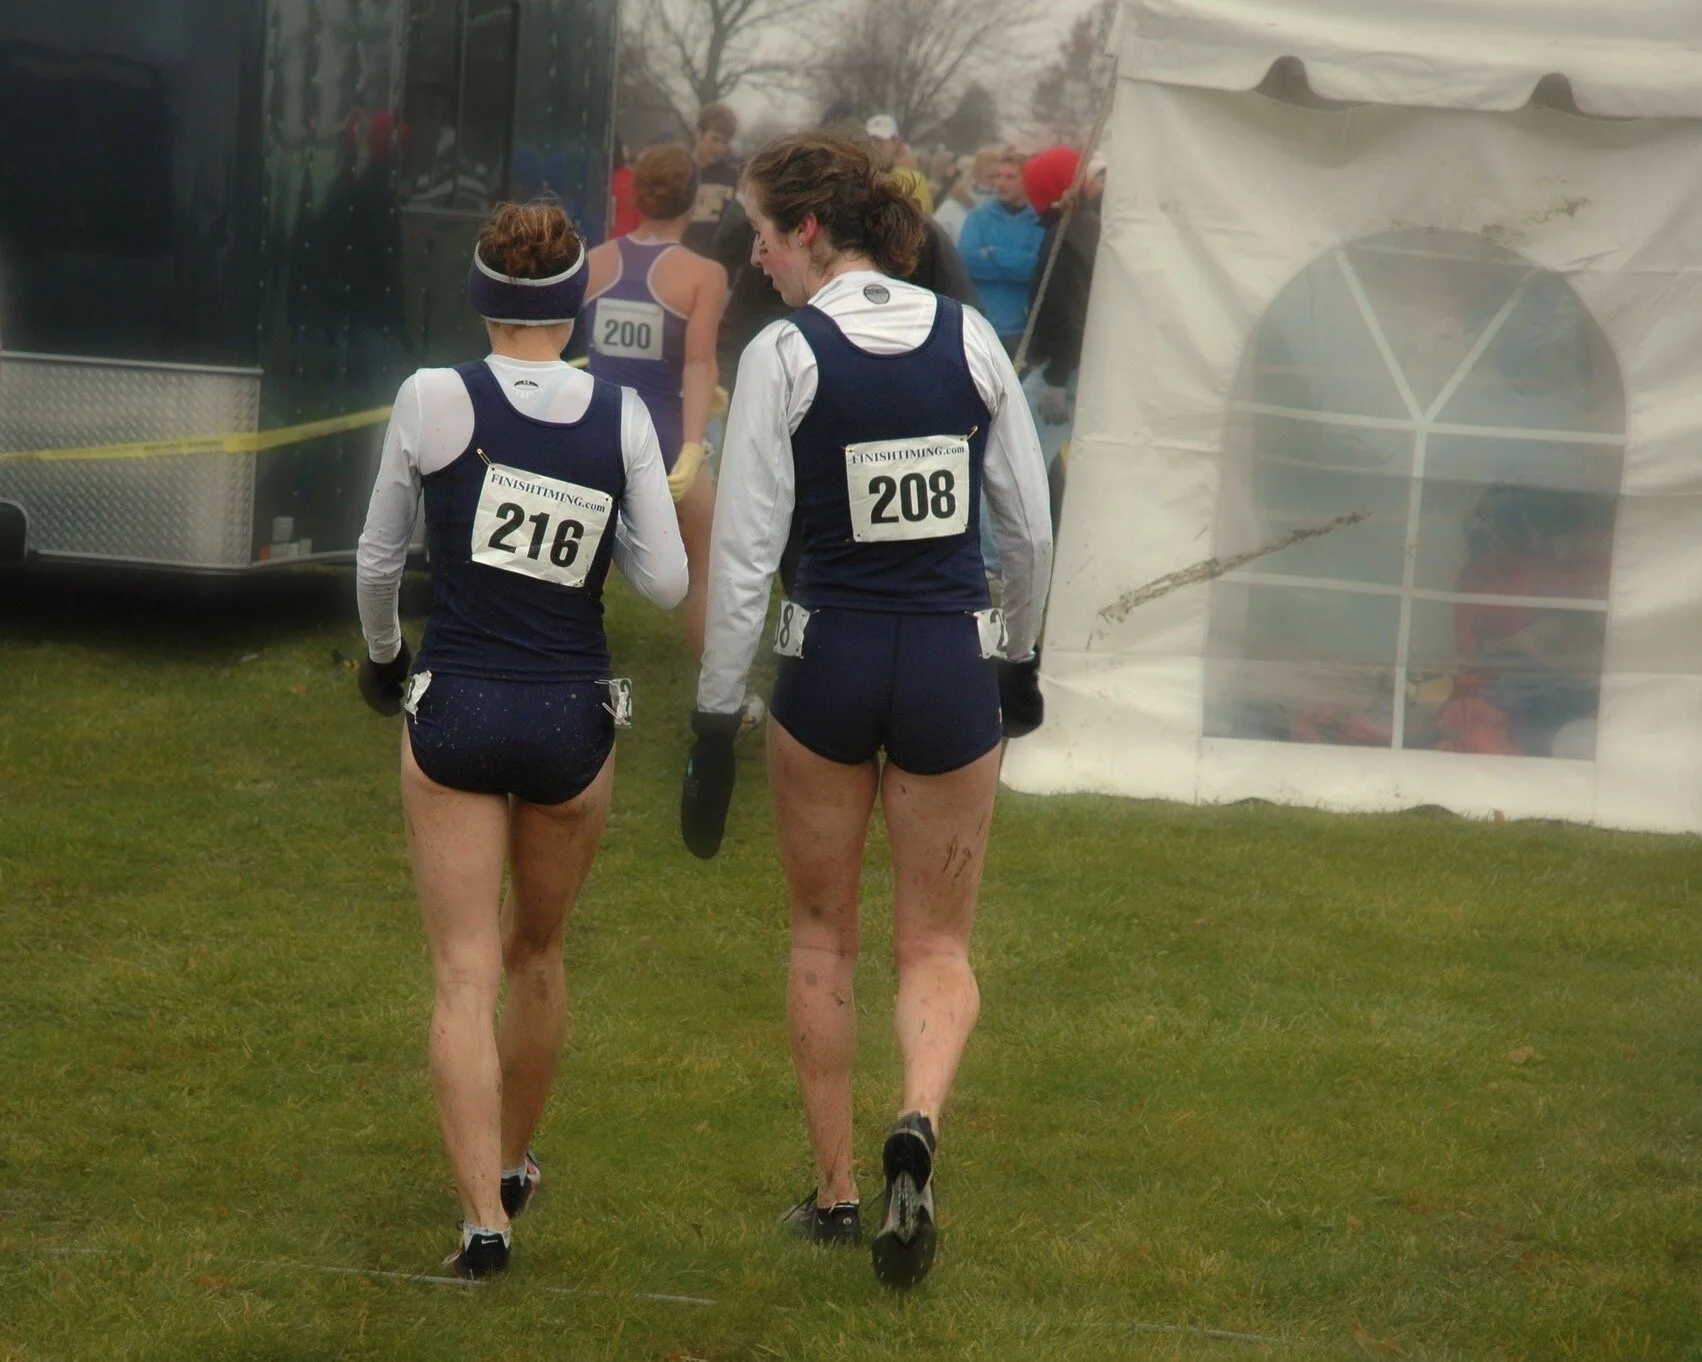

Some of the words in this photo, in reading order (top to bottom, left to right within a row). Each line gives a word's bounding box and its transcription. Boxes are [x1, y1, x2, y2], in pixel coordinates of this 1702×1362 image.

[603, 318, 651, 350] 200
[852, 445, 965, 464] FINISHTIMING.com
[491, 473, 606, 513] FINISHTIMING.com
[868, 469, 956, 524] 208
[488, 502, 585, 568] 216
[775, 604, 794, 648] 8
